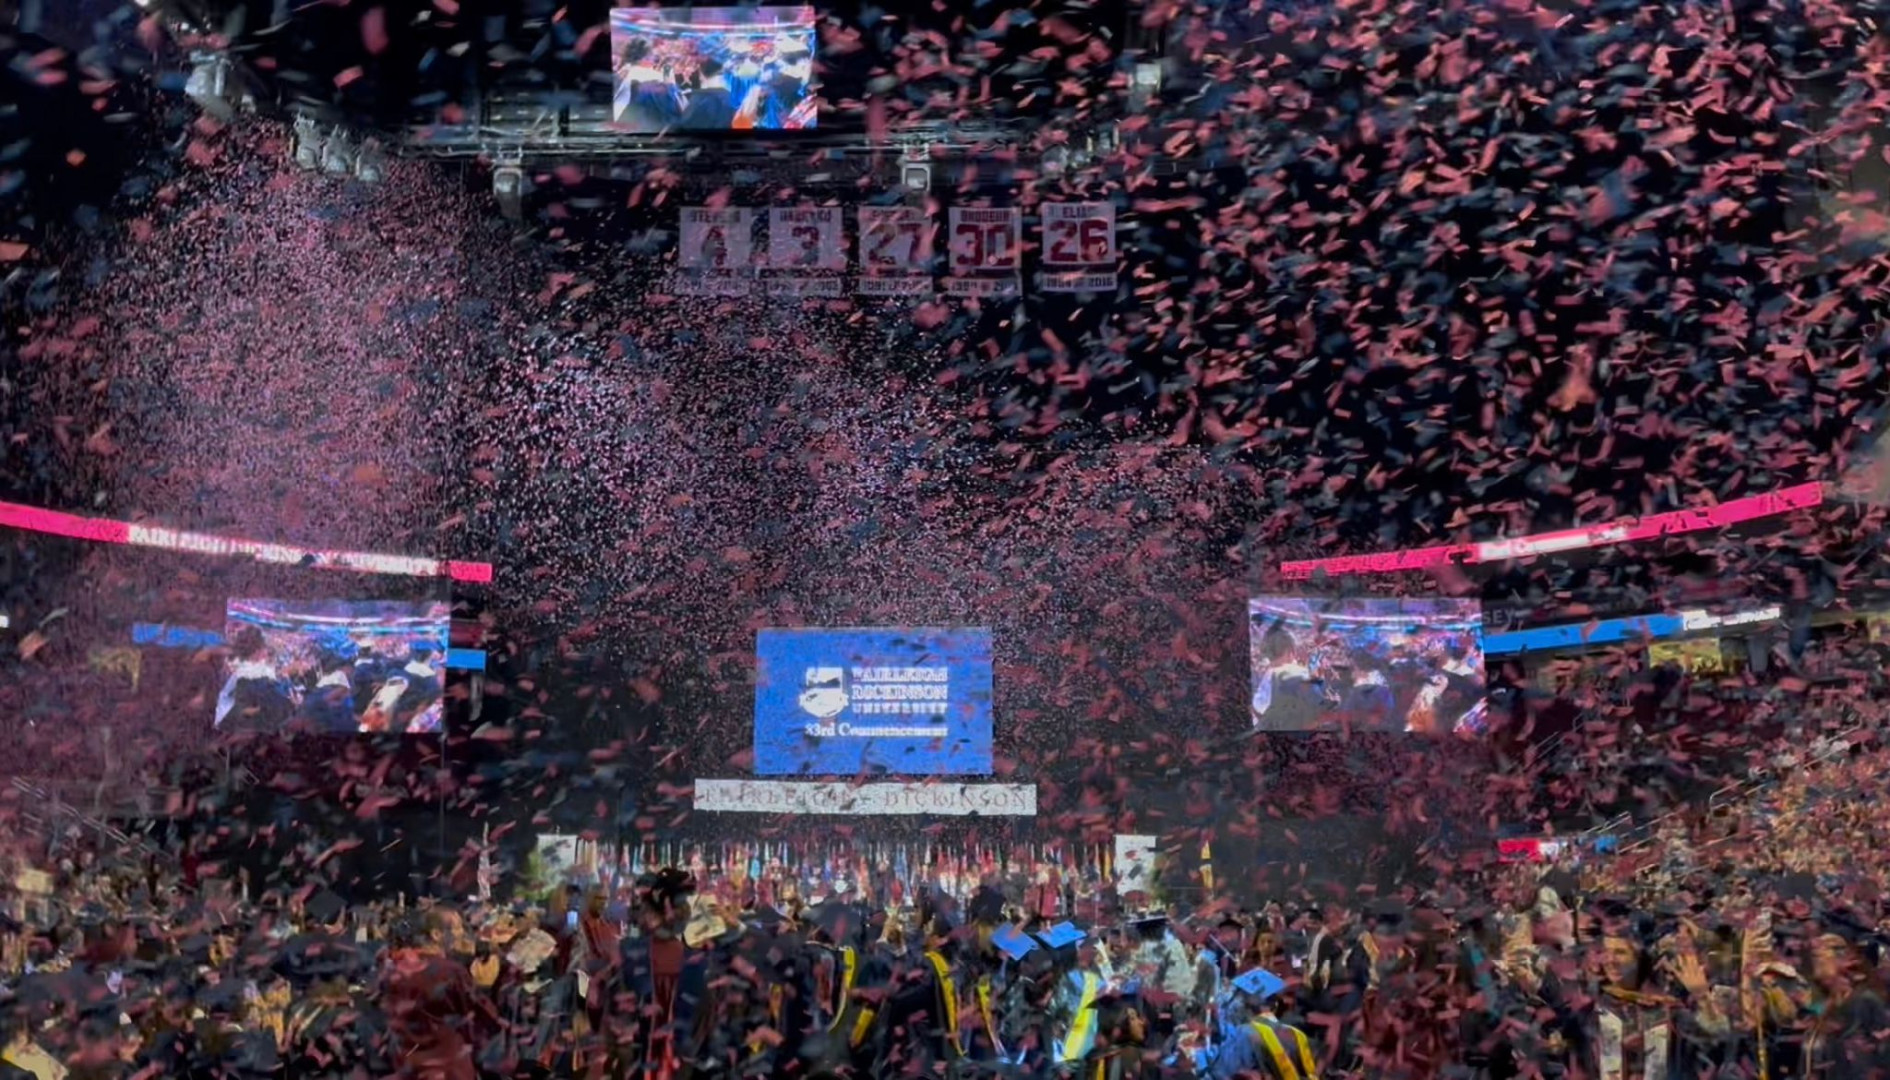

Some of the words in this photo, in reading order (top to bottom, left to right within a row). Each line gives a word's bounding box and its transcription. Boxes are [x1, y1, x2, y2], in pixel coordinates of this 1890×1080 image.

[867, 223, 922, 266] 27
[955, 223, 1015, 266] 30
[1049, 219, 1109, 262] 26
